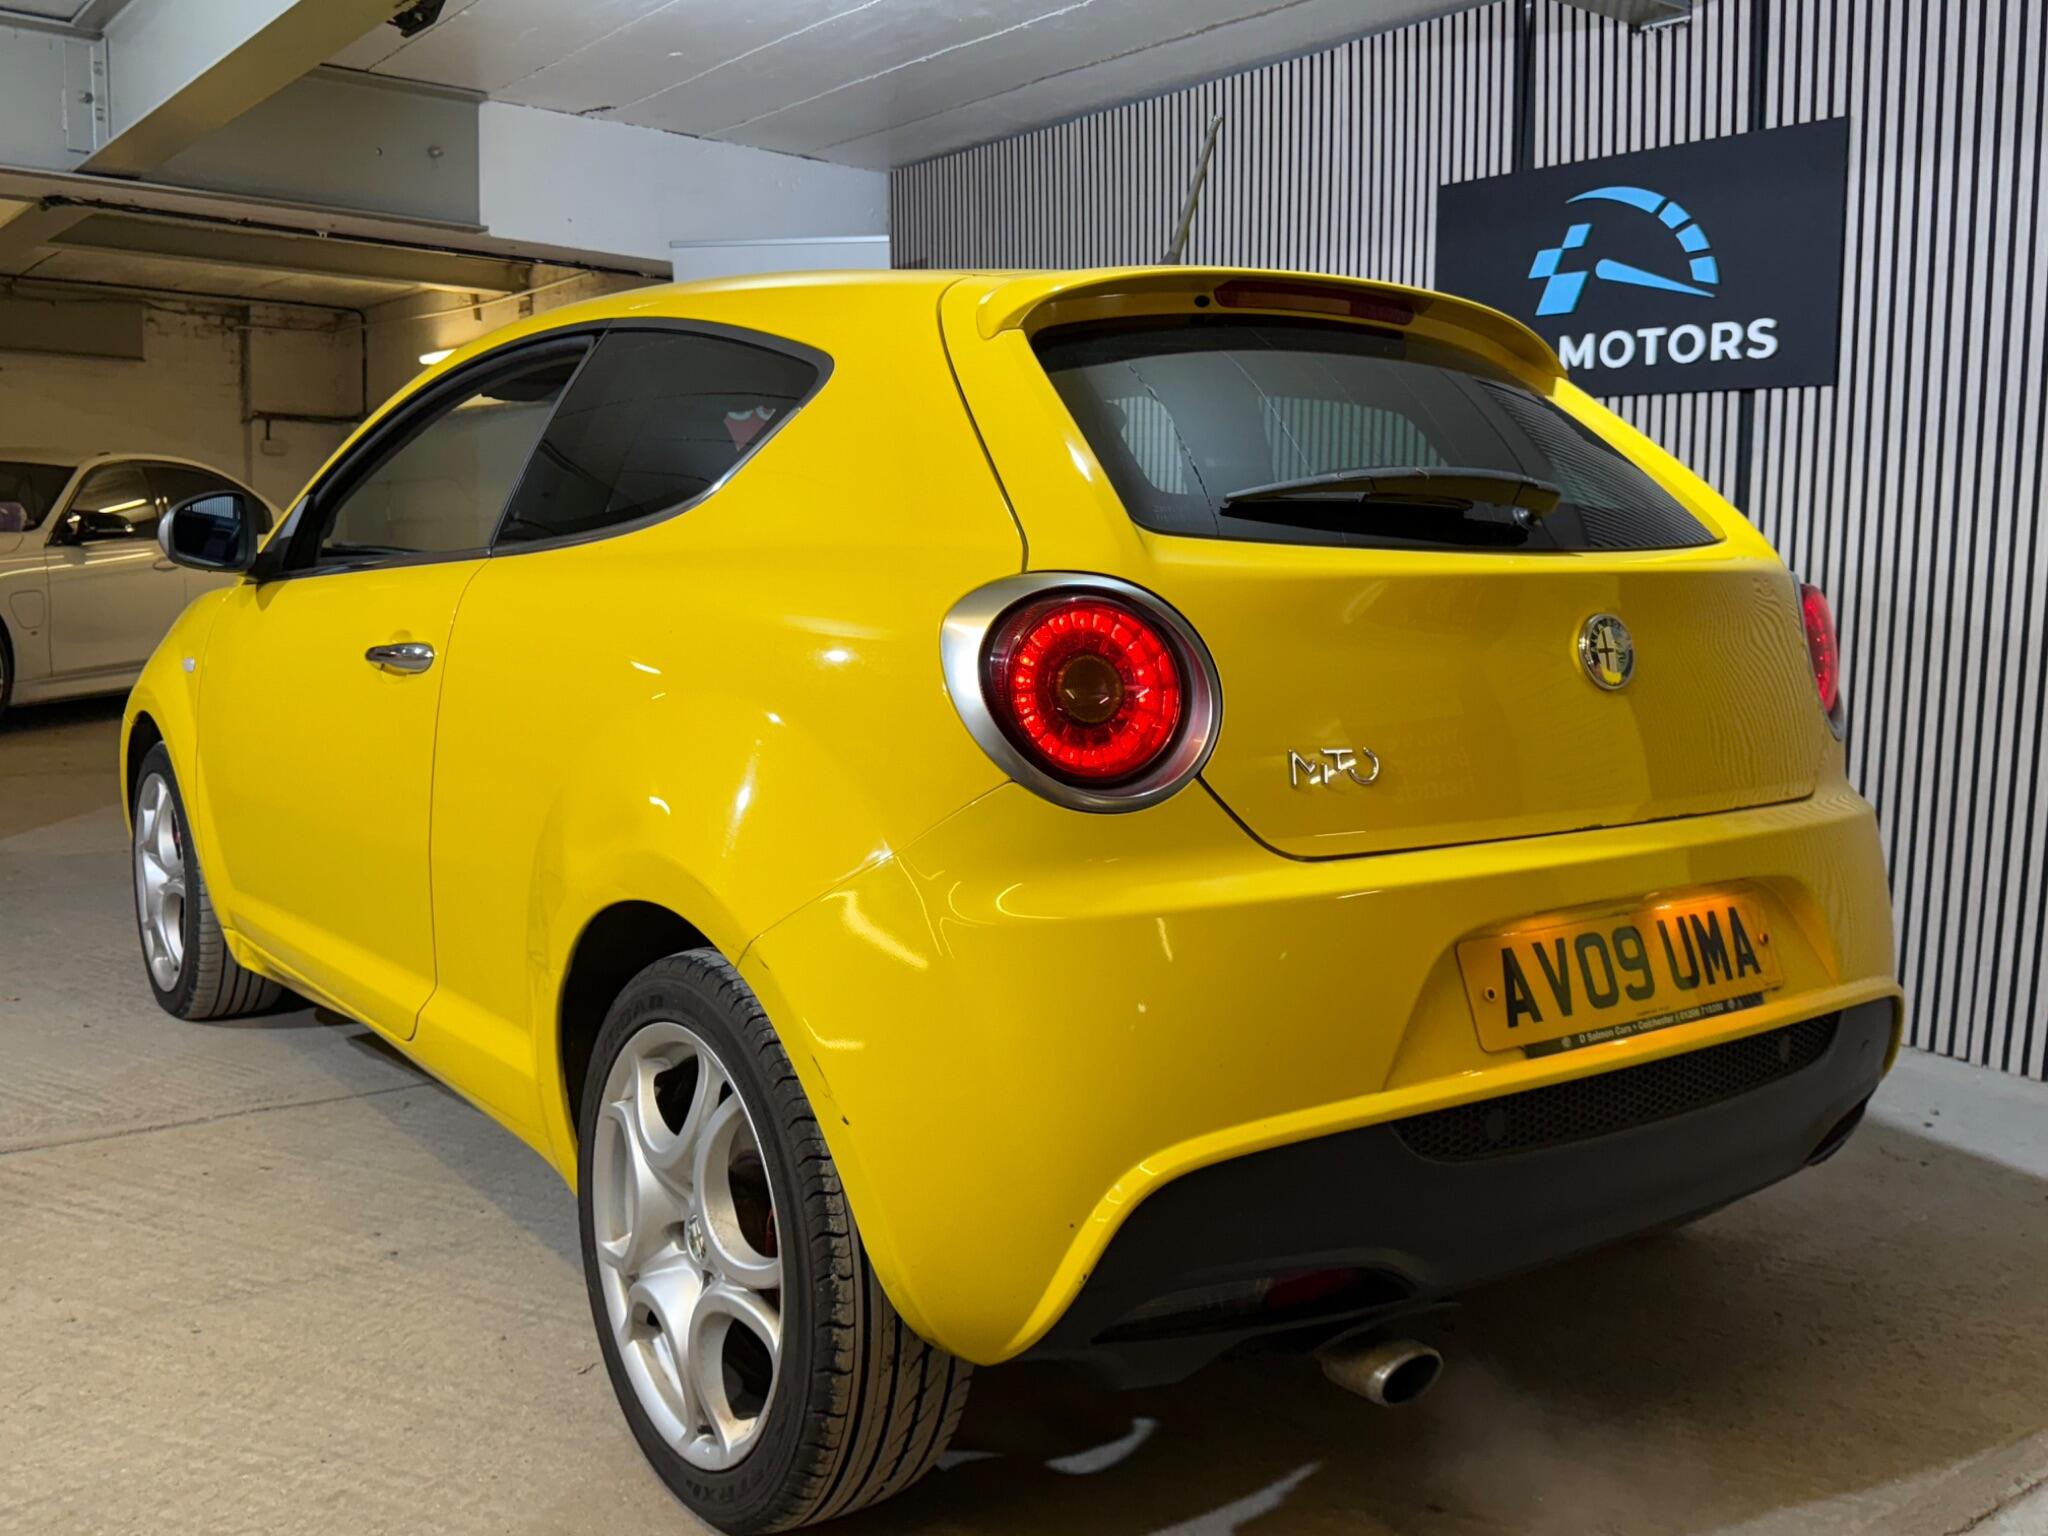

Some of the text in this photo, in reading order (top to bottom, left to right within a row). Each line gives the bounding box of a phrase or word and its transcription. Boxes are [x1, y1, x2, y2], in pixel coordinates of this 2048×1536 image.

[1559, 317, 1778, 370] MOTORS
[1501, 907, 1763, 1028] AV09 UMA
